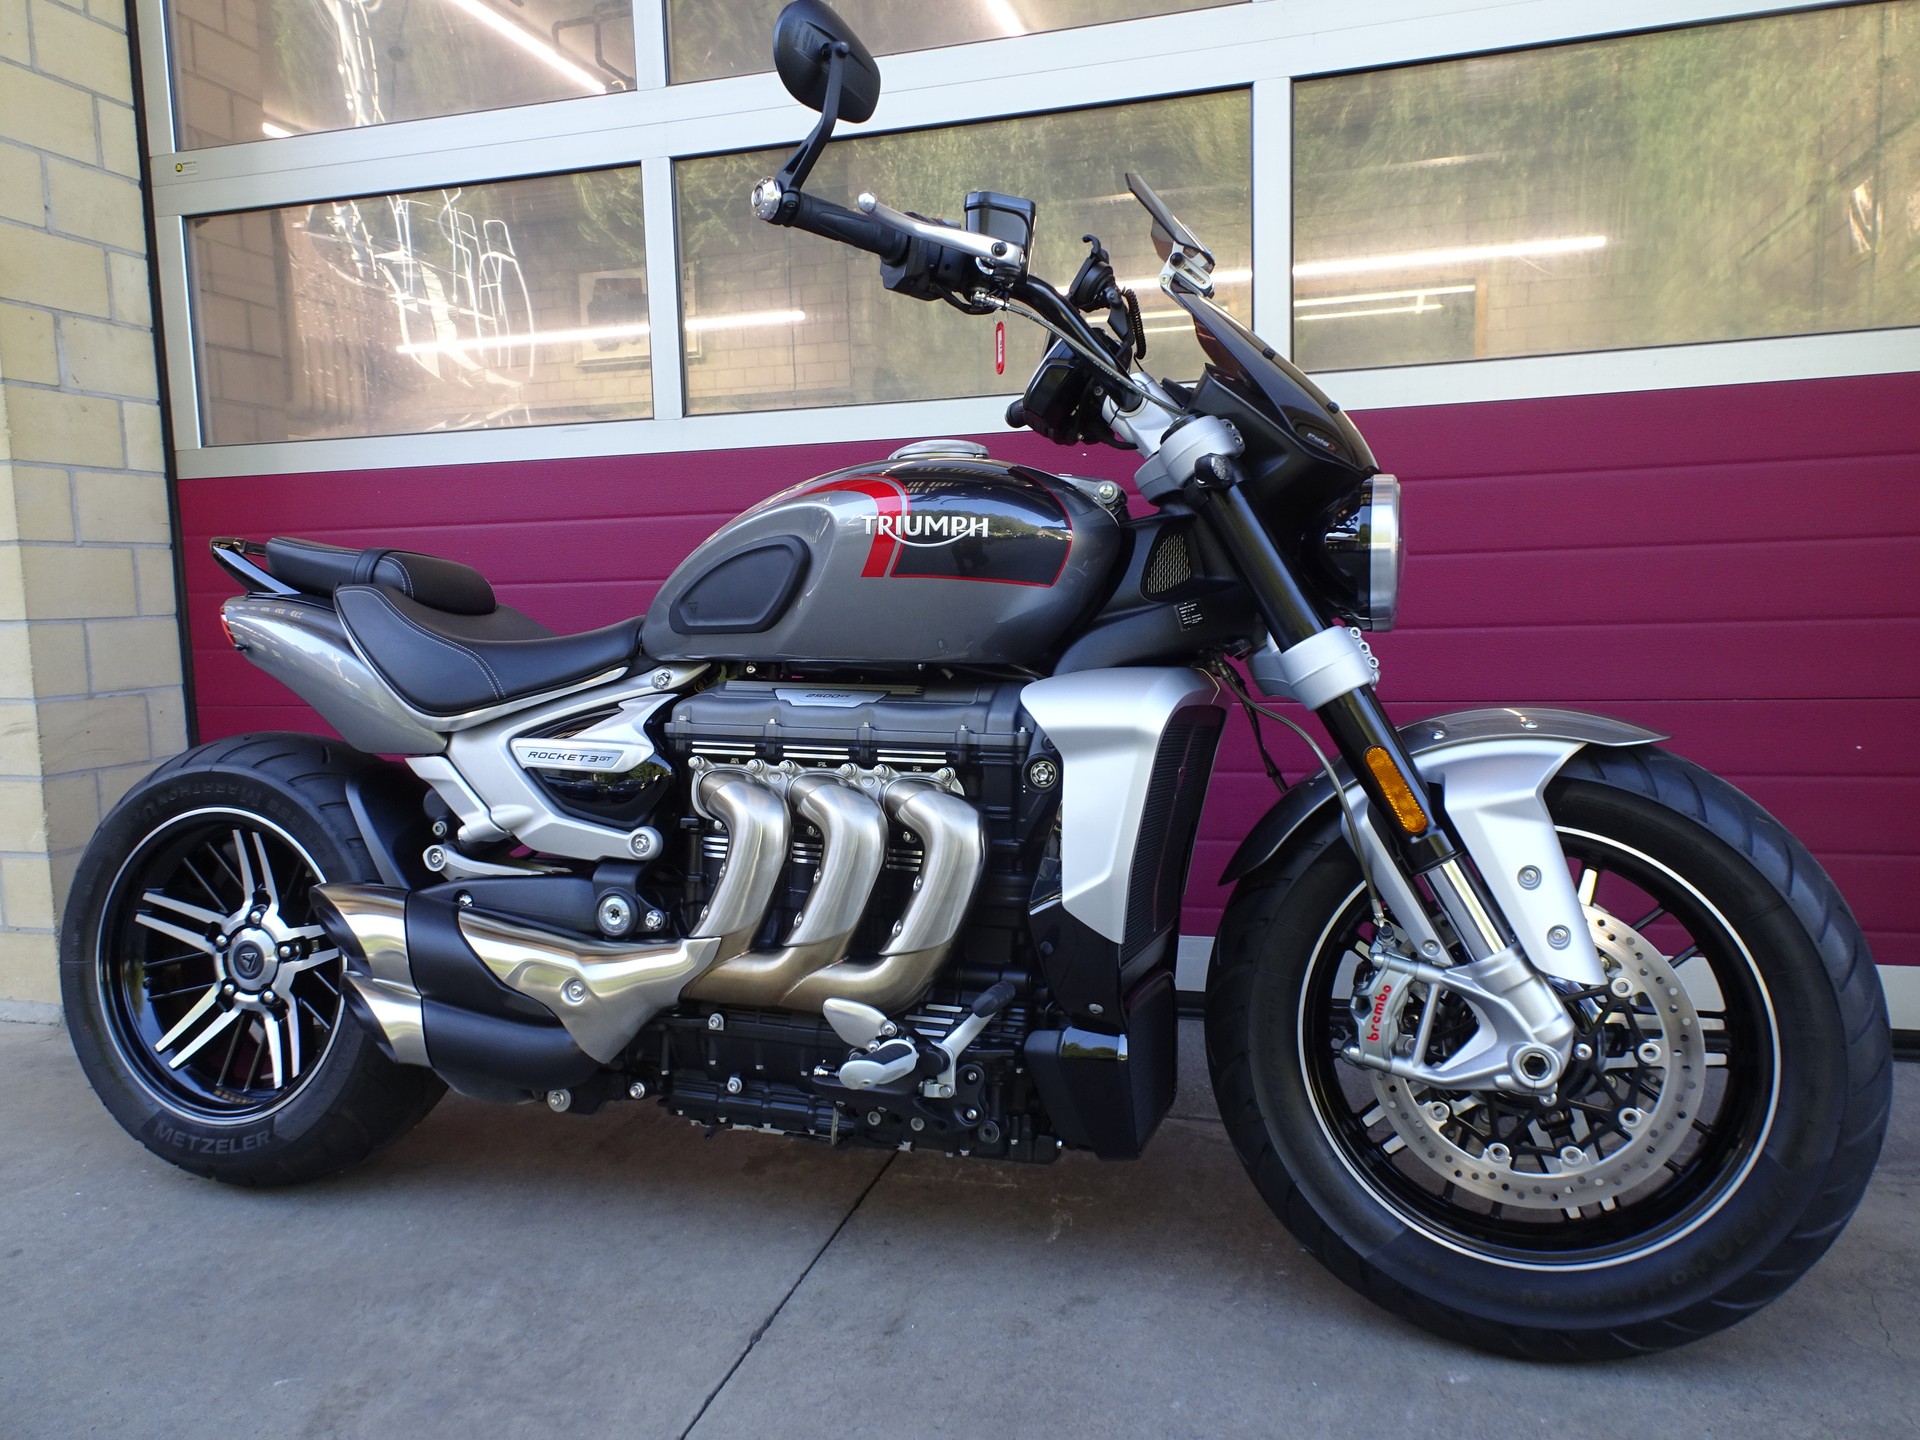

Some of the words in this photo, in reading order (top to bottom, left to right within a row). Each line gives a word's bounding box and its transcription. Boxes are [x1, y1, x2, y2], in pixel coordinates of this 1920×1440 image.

[861, 515, 989, 546] TRIUMPH
[1366, 985, 1392, 1041] brembo
[153, 1123, 271, 1155] METZELER
